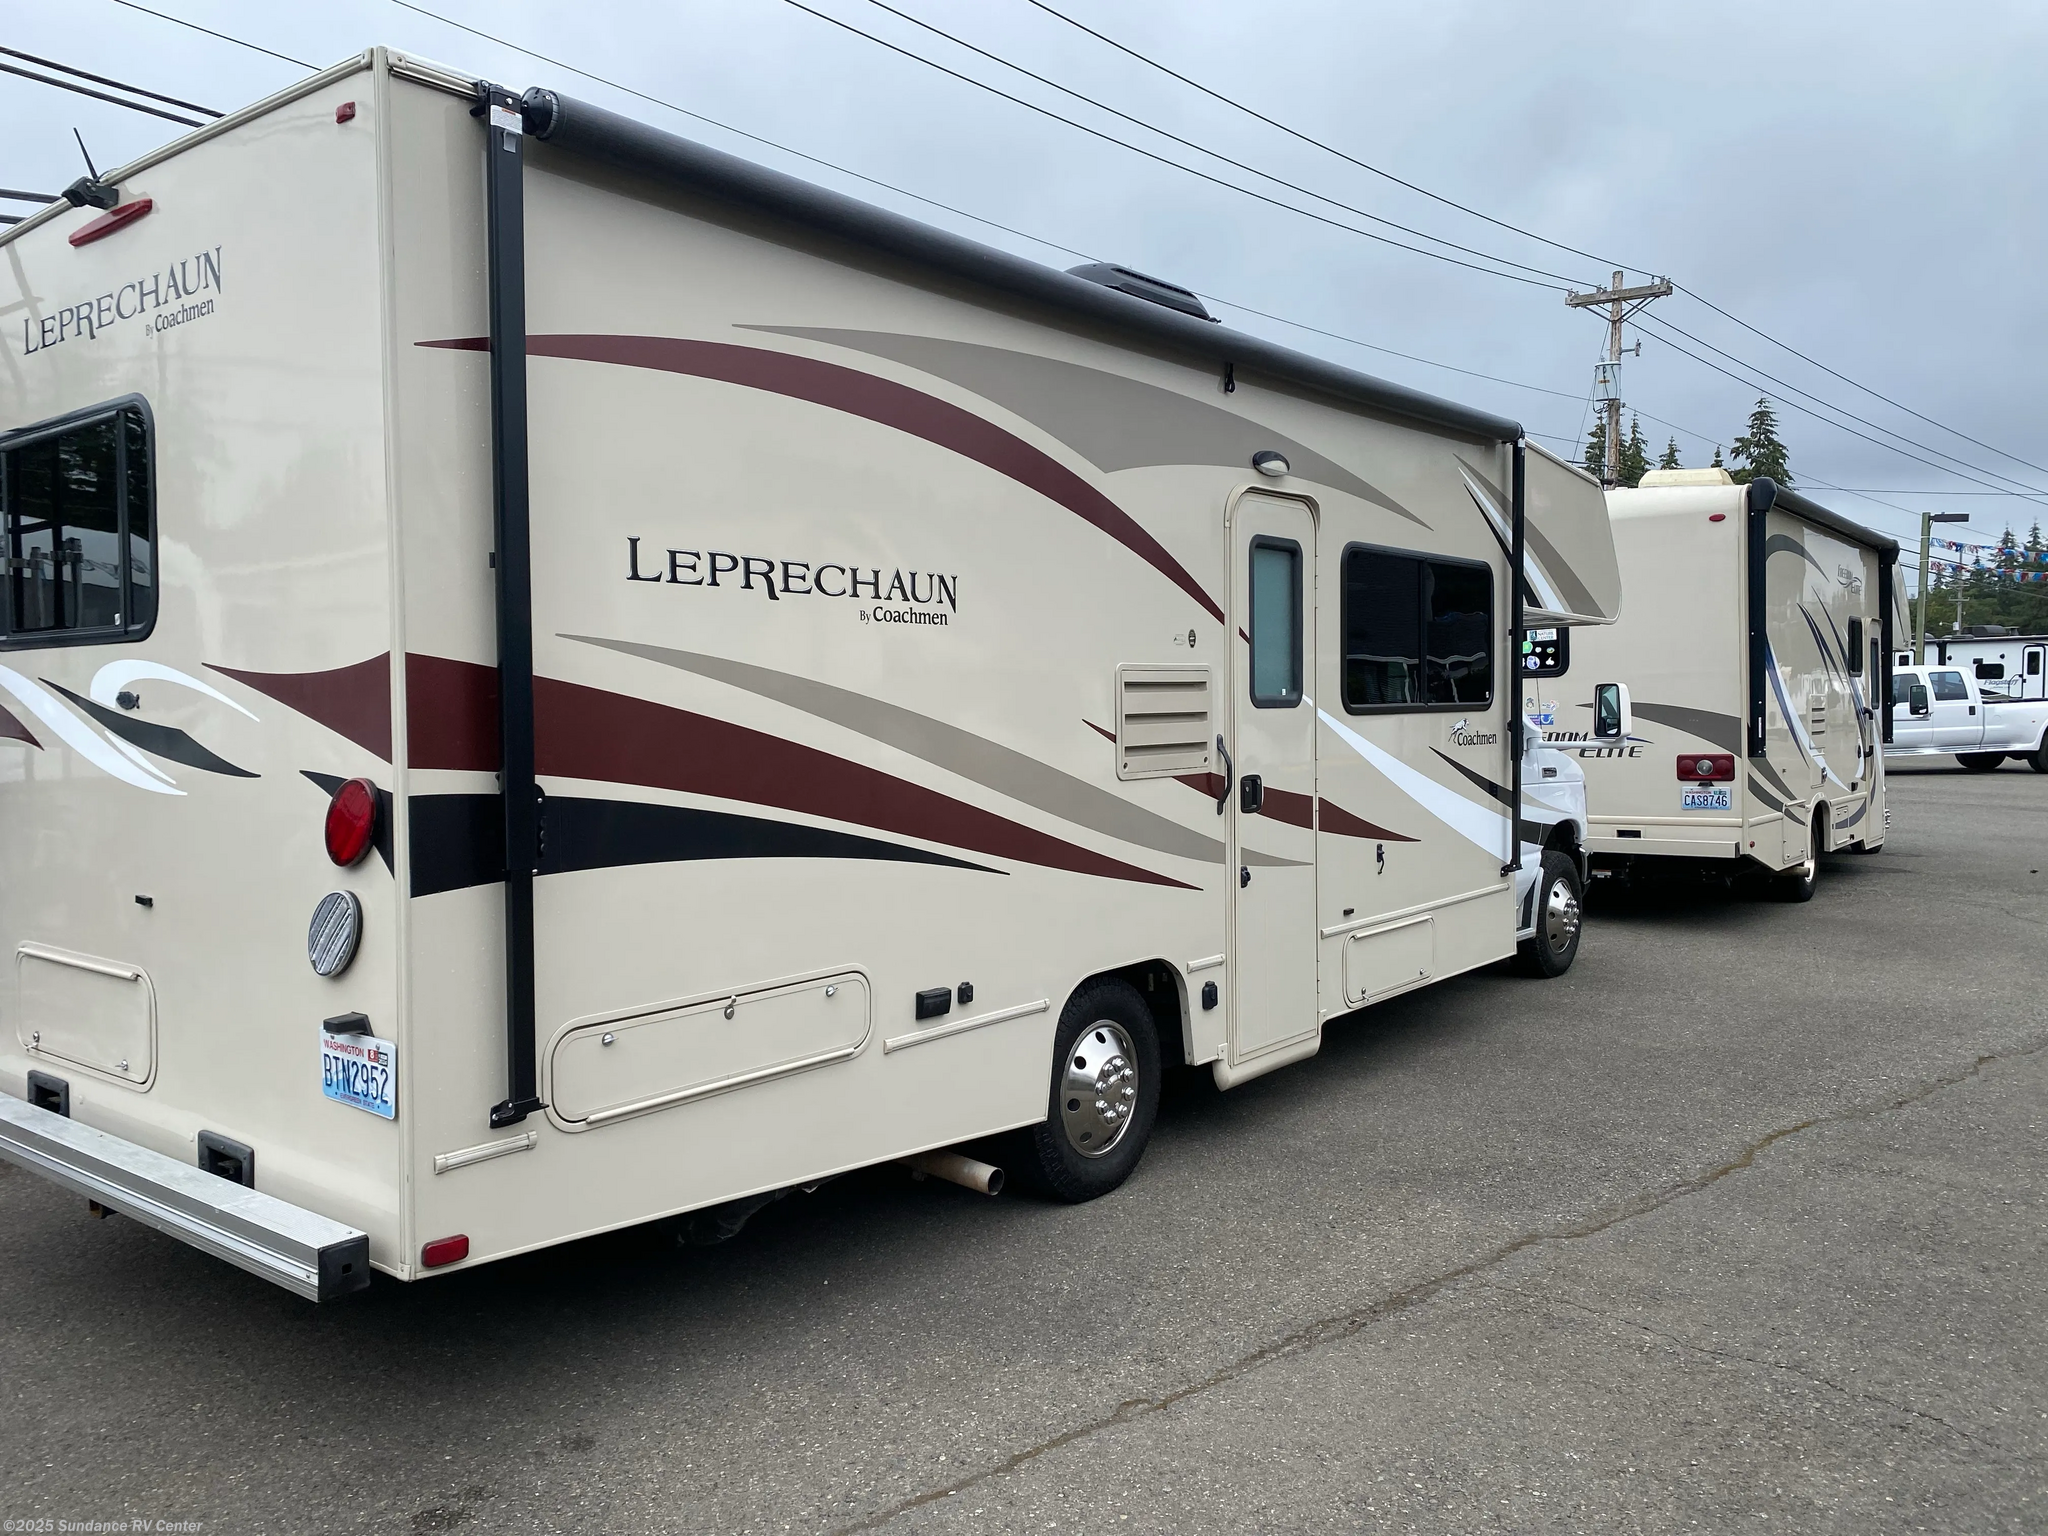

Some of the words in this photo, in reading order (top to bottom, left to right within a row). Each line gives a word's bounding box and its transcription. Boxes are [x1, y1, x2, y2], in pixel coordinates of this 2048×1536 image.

[24, 245, 221, 355] LEPRECHAUN
[146, 324, 154, 339] By
[155, 299, 214, 333] Coachmen
[626, 535, 958, 613] LEPRECHAUN
[860, 610, 872, 624] By
[873, 606, 948, 626] Coachmen
[1457, 731, 1497, 747] Coachmen
[1579, 746, 1644, 758] ELITE
[1684, 795, 1728, 806] CAS8746
[323, 1039, 364, 1058] WASHINGTON
[324, 1053, 389, 1105] BTN2952
